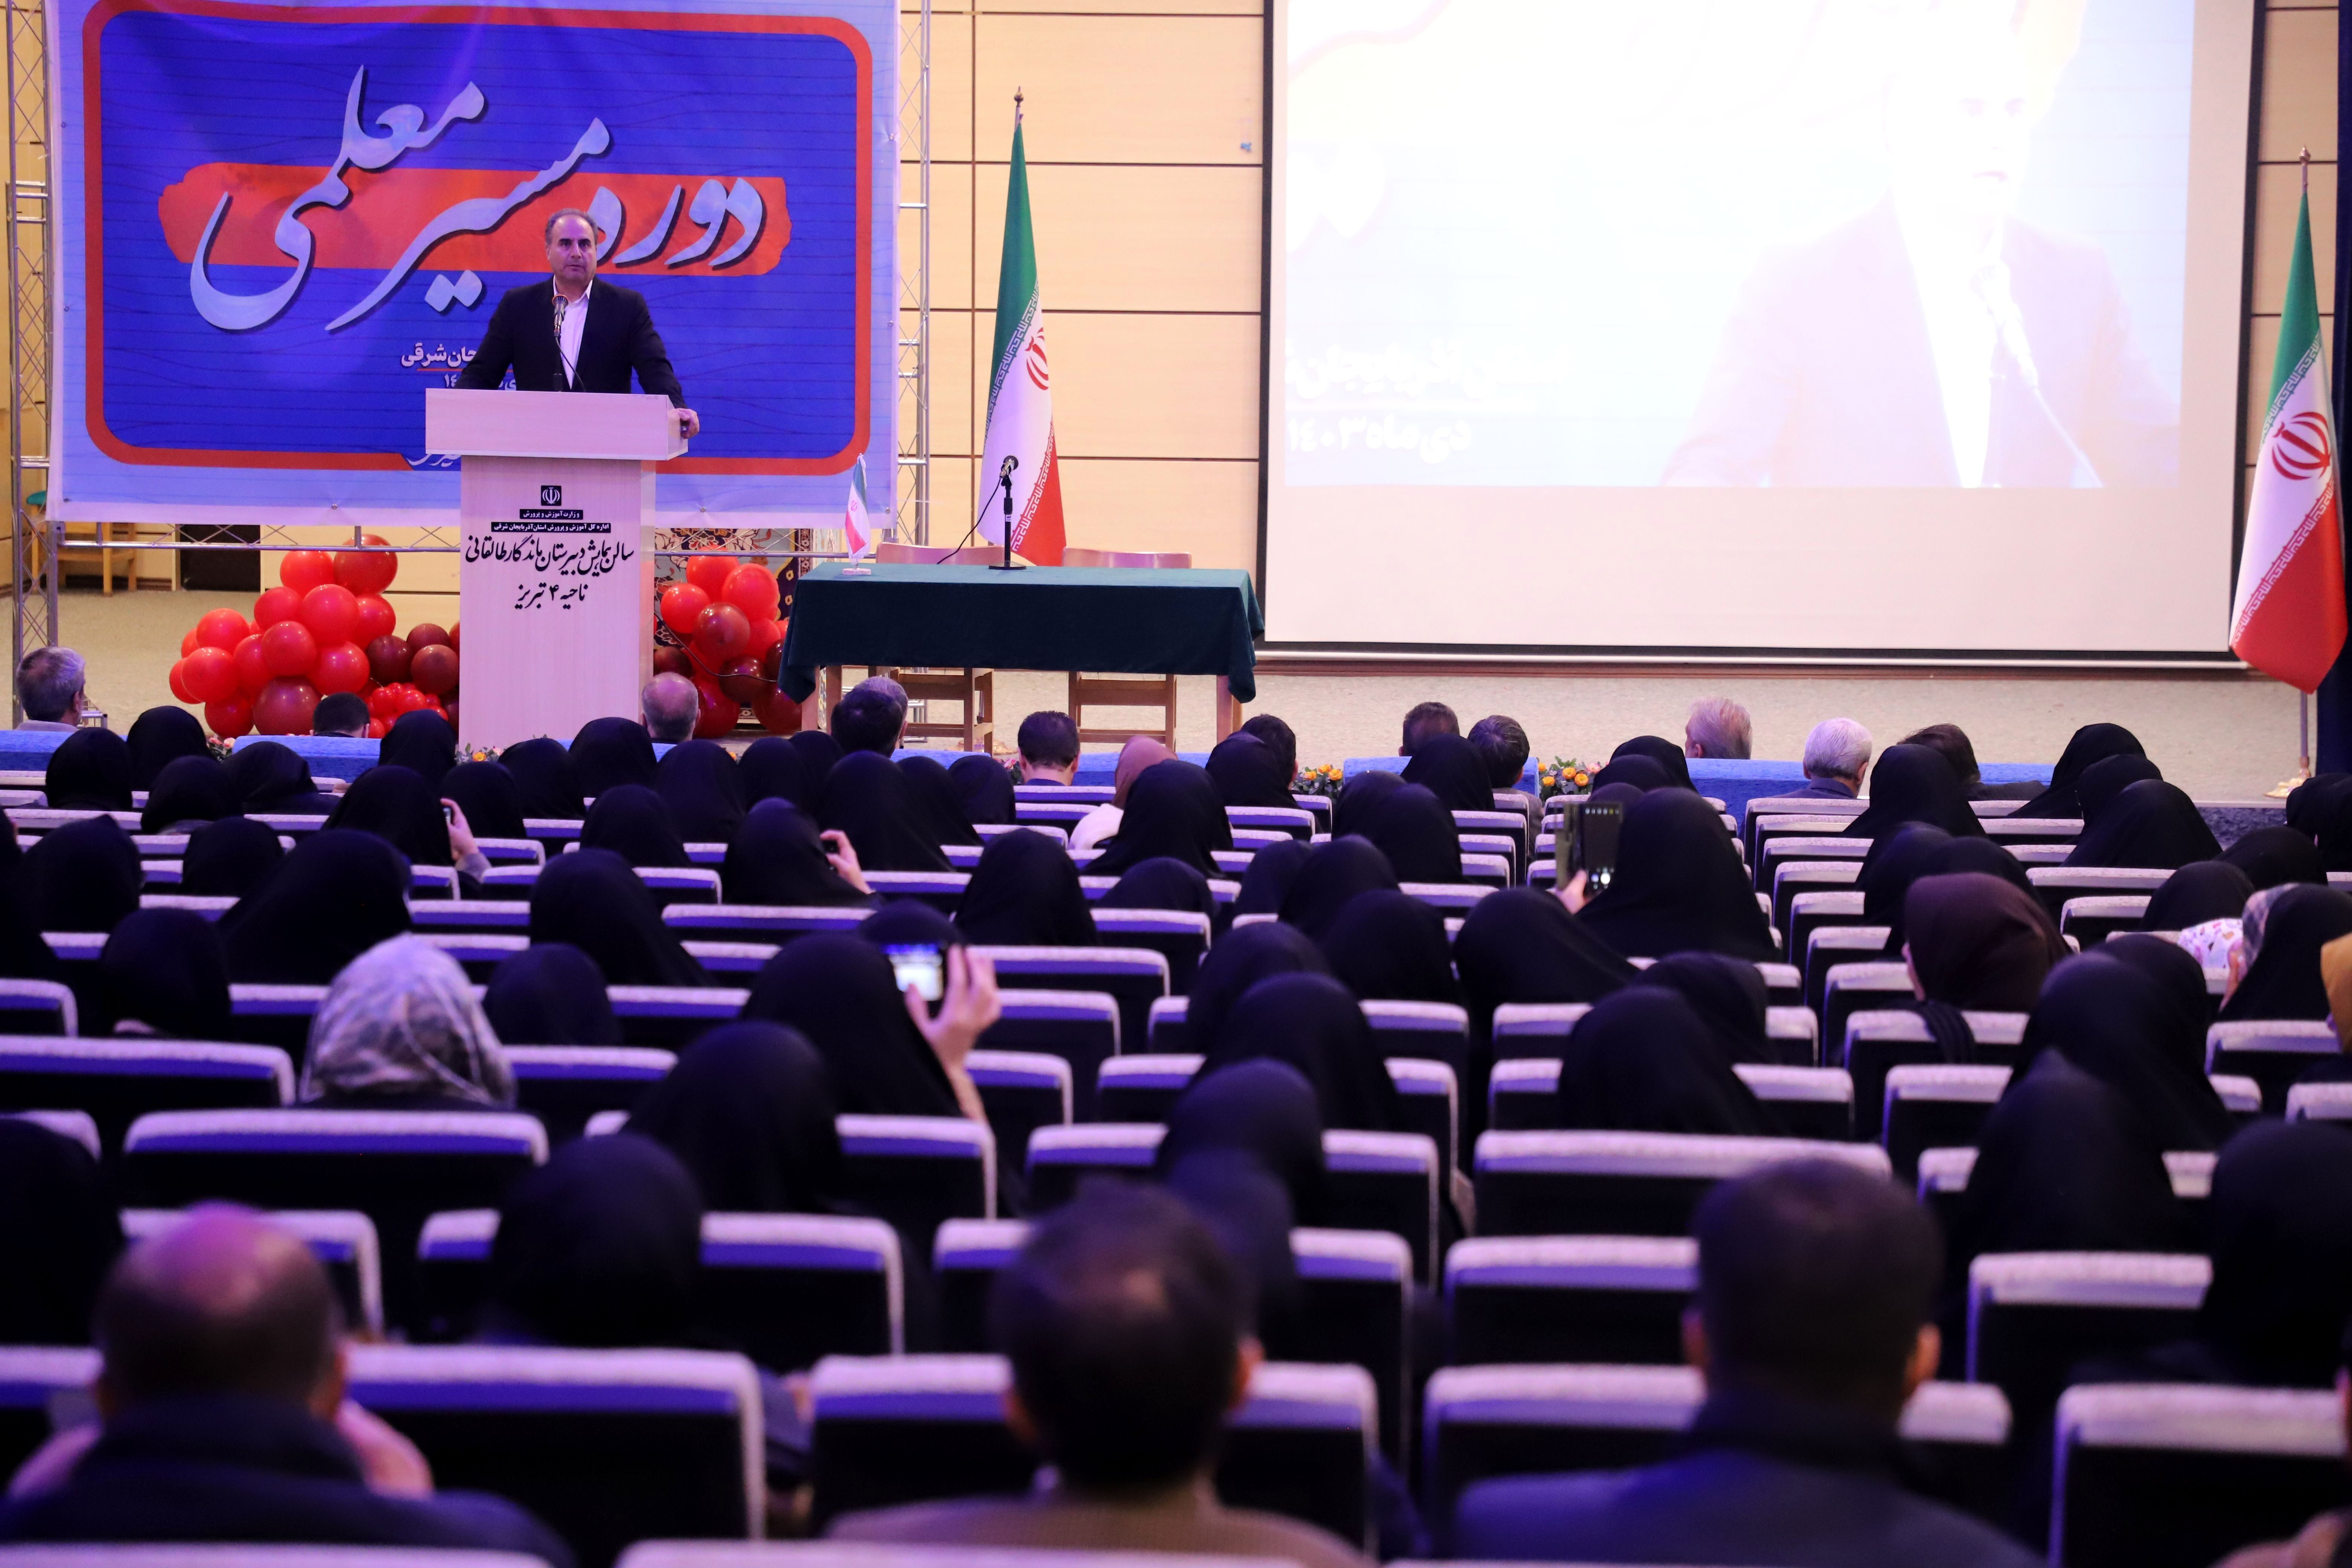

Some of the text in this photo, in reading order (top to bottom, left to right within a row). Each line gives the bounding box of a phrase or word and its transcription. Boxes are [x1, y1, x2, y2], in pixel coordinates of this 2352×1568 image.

[190, 64, 764, 332] دوره مسیر معلمی
[466, 535, 507, 562] طالقانی
[535, 543, 585, 575] دبیرستان
[600, 541, 634, 573] سالن
[514, 582, 547, 609] تبریز
[560, 584, 588, 609] ناحیه
